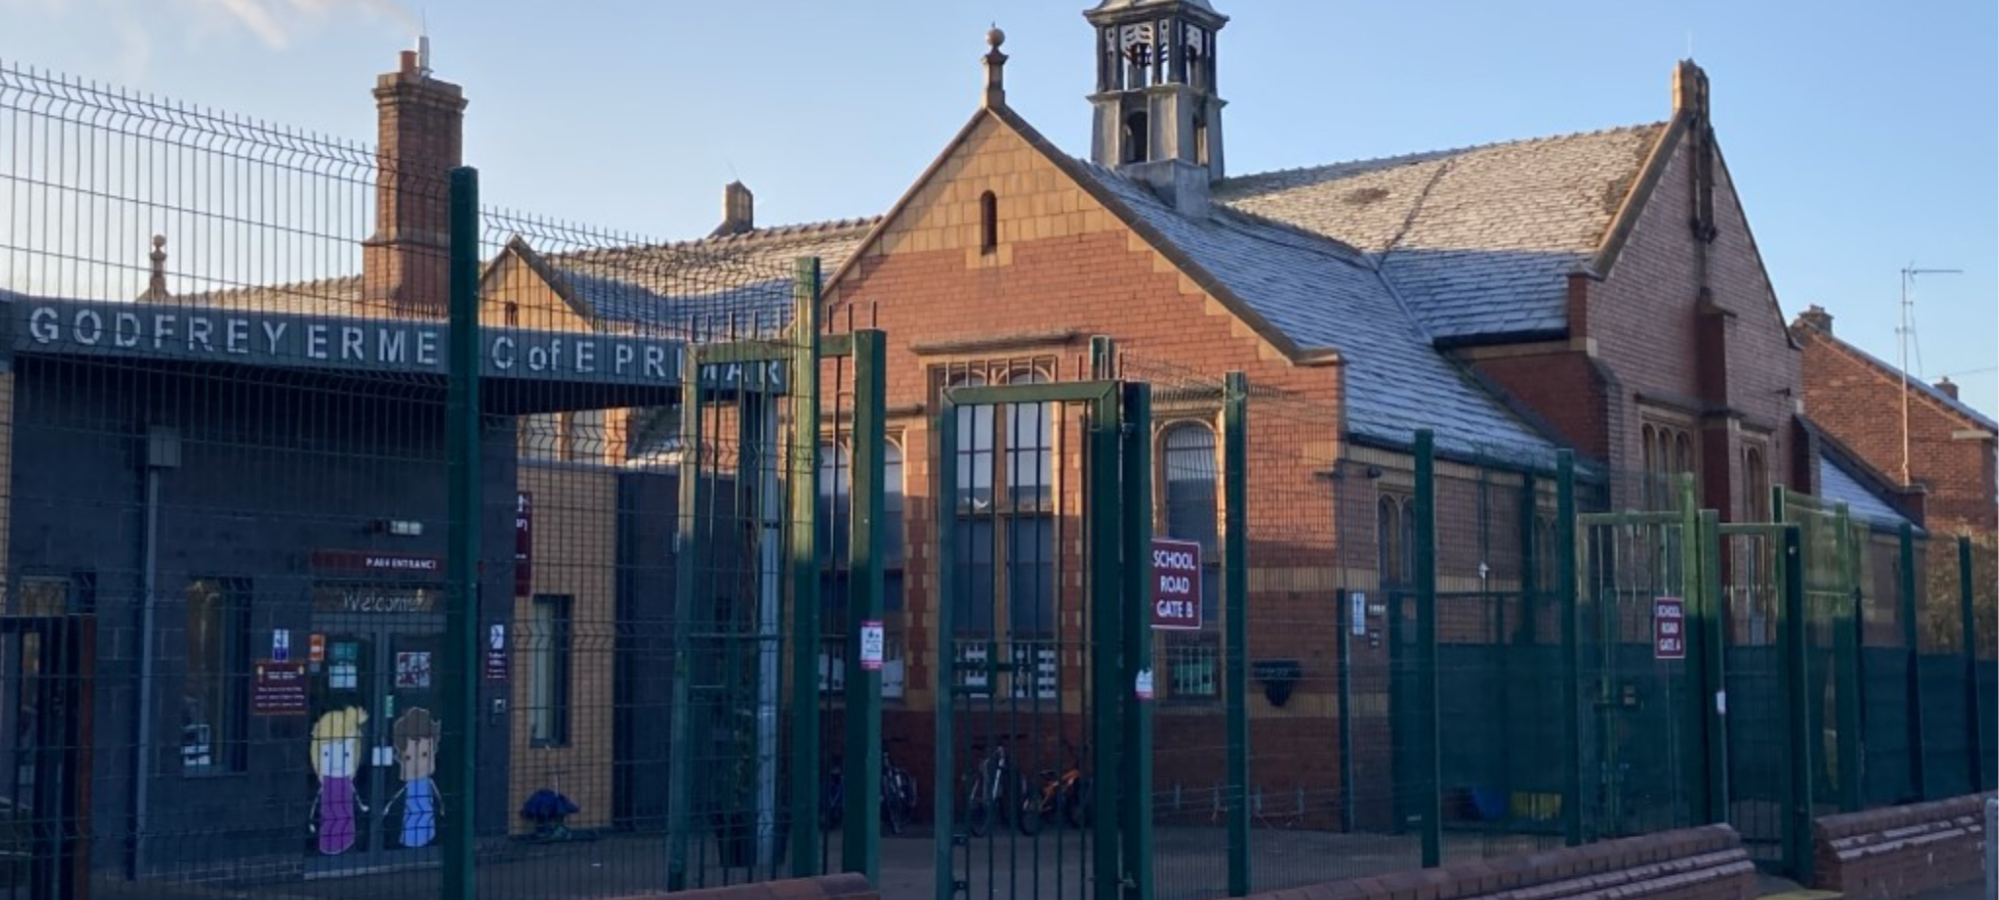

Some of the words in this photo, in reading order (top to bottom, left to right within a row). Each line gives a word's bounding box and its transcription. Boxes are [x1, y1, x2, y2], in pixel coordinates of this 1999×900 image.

[29, 307, 287, 355] GODFREY
[307, 324, 440, 365] ERME
[491, 336, 515, 370] C
[528, 339, 562, 372] of
[576, 342, 596, 373] E
[1153, 550, 1196, 570] SCHOOL
[1160, 575, 1190, 594] ROAD
[1156, 599, 1184, 619] GATE
[1186, 601, 1194, 619] B
